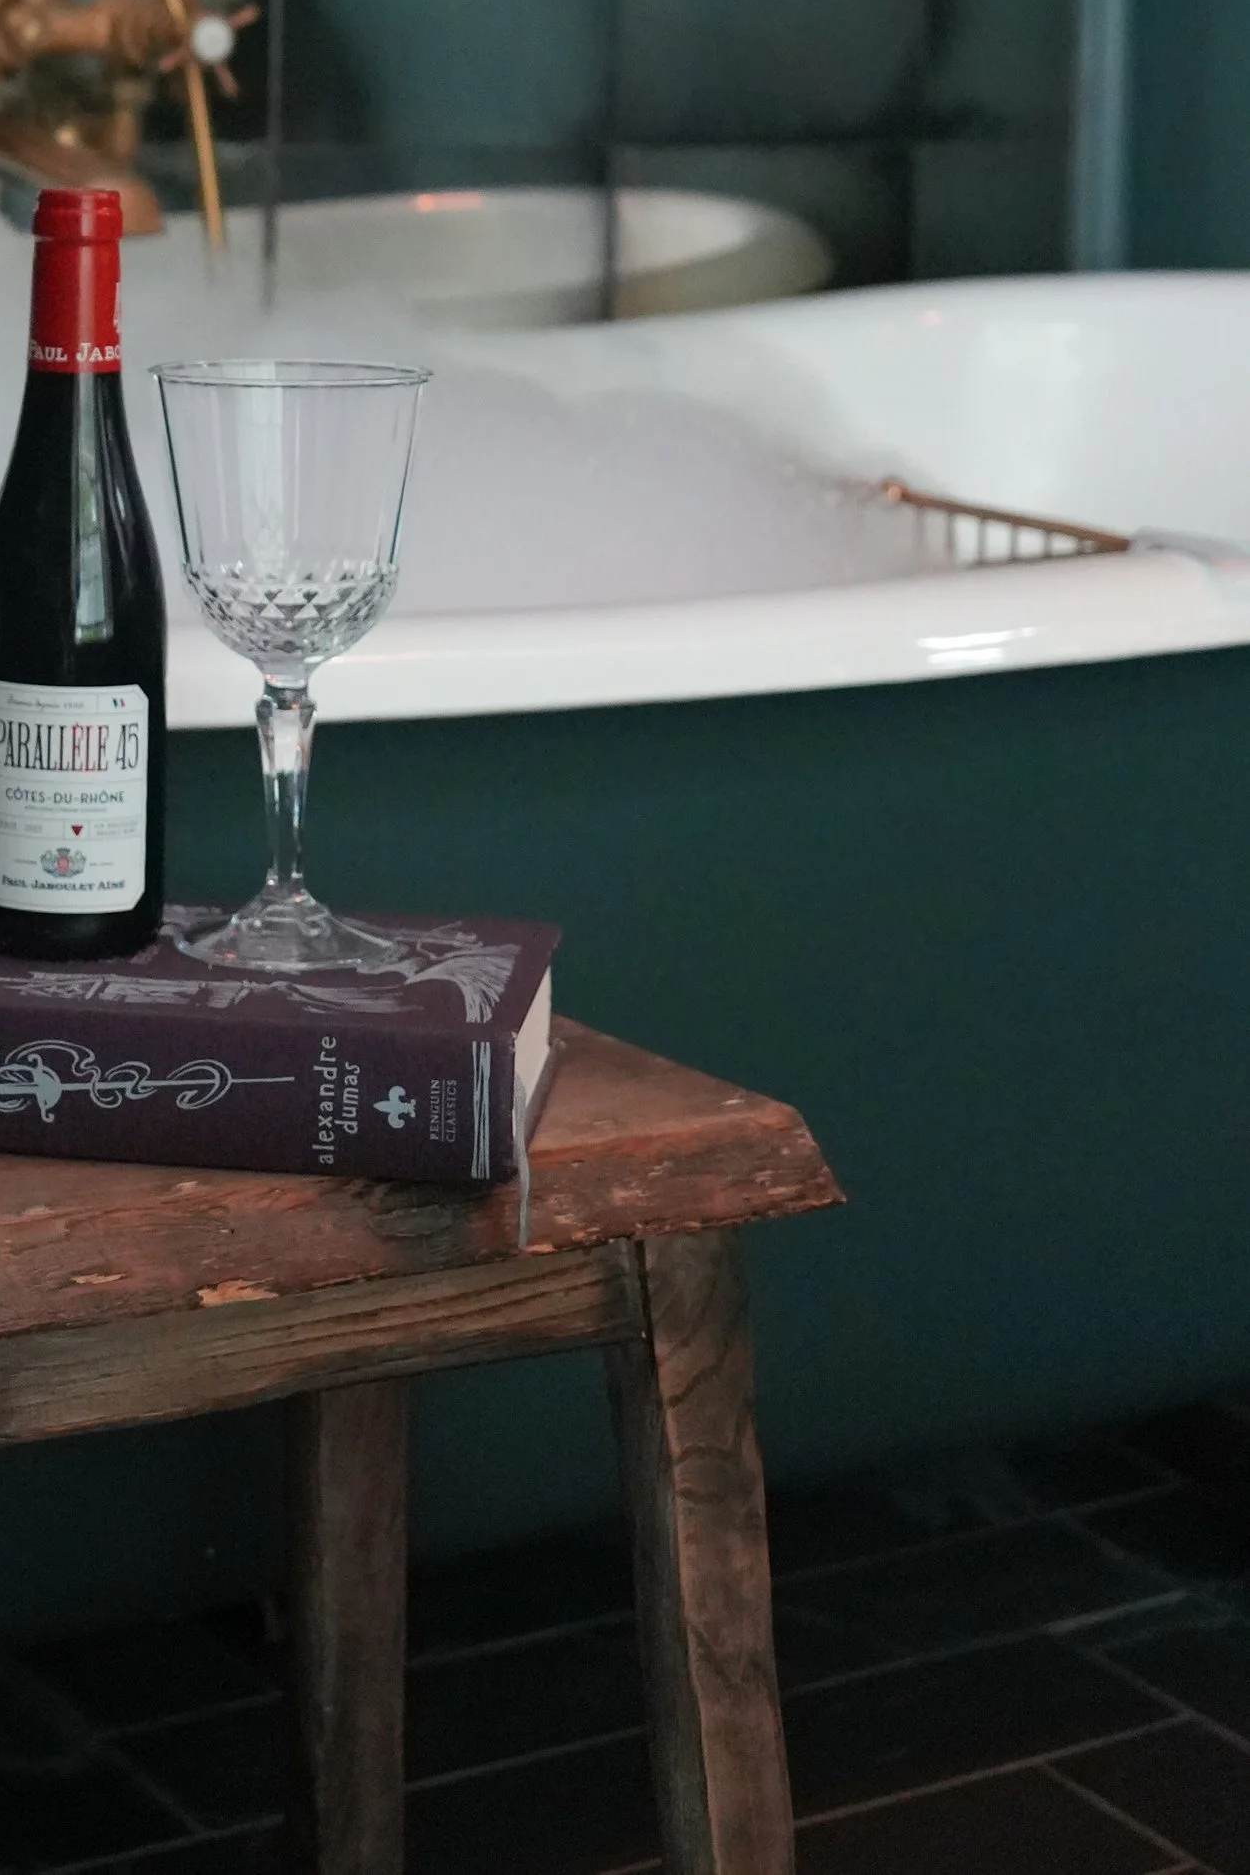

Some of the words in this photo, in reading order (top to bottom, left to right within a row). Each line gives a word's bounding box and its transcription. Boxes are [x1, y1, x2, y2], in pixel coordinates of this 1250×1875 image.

[115, 723, 140, 770] 45
[312, 1035, 337, 1165] alexandre
[335, 1061, 360, 1135] dumas
[429, 1078, 440, 1141] PENGUIN
[446, 1078, 457, 1143] CLASSICS
